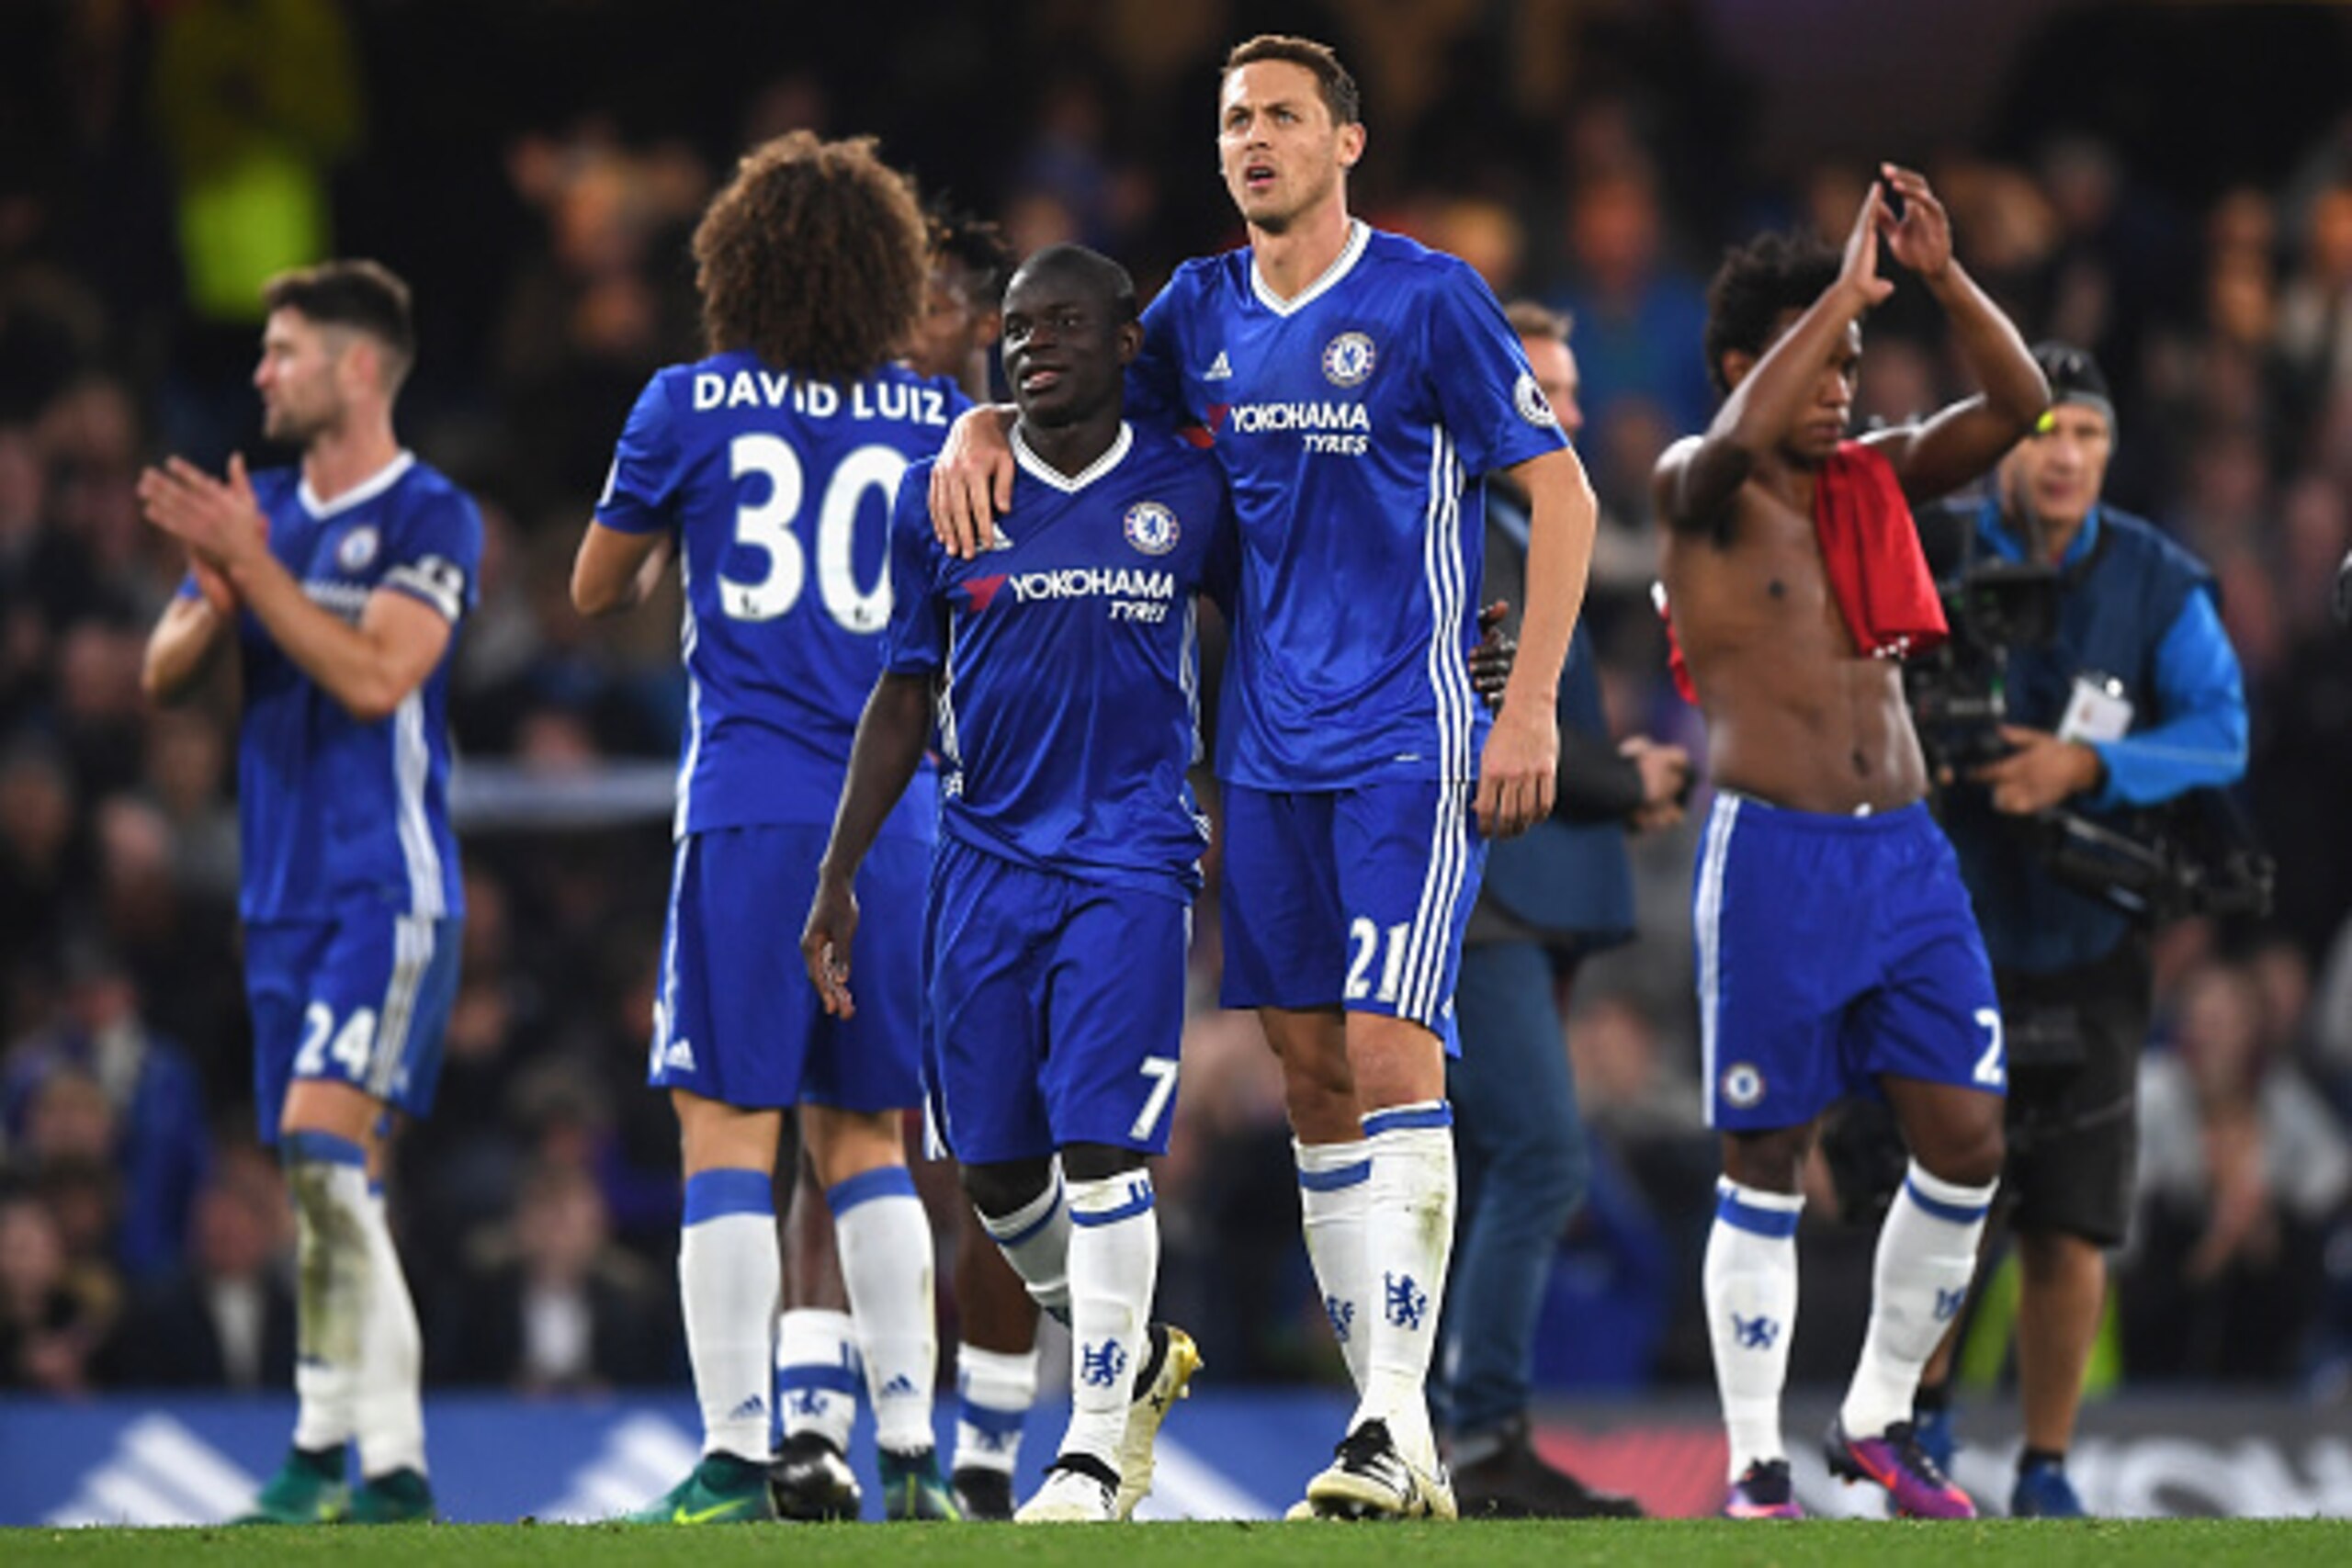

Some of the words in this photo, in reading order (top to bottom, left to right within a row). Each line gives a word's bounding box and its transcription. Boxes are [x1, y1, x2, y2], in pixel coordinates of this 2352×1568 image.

[694, 370, 839, 418] DAVID
[854, 381, 948, 426] LUIZ
[1230, 401, 1371, 434] YOKOHAMA
[1303, 434, 1369, 455] TYRES
[718, 433, 894, 635] 30
[1009, 567, 1174, 603] YOKOHAMA
[1108, 601, 1169, 624] TYRES
[1343, 915, 1410, 1002] 21
[295, 1000, 377, 1080] 24
[1973, 1009, 2005, 1086] 2
[1129, 1056, 1178, 1141] 7
